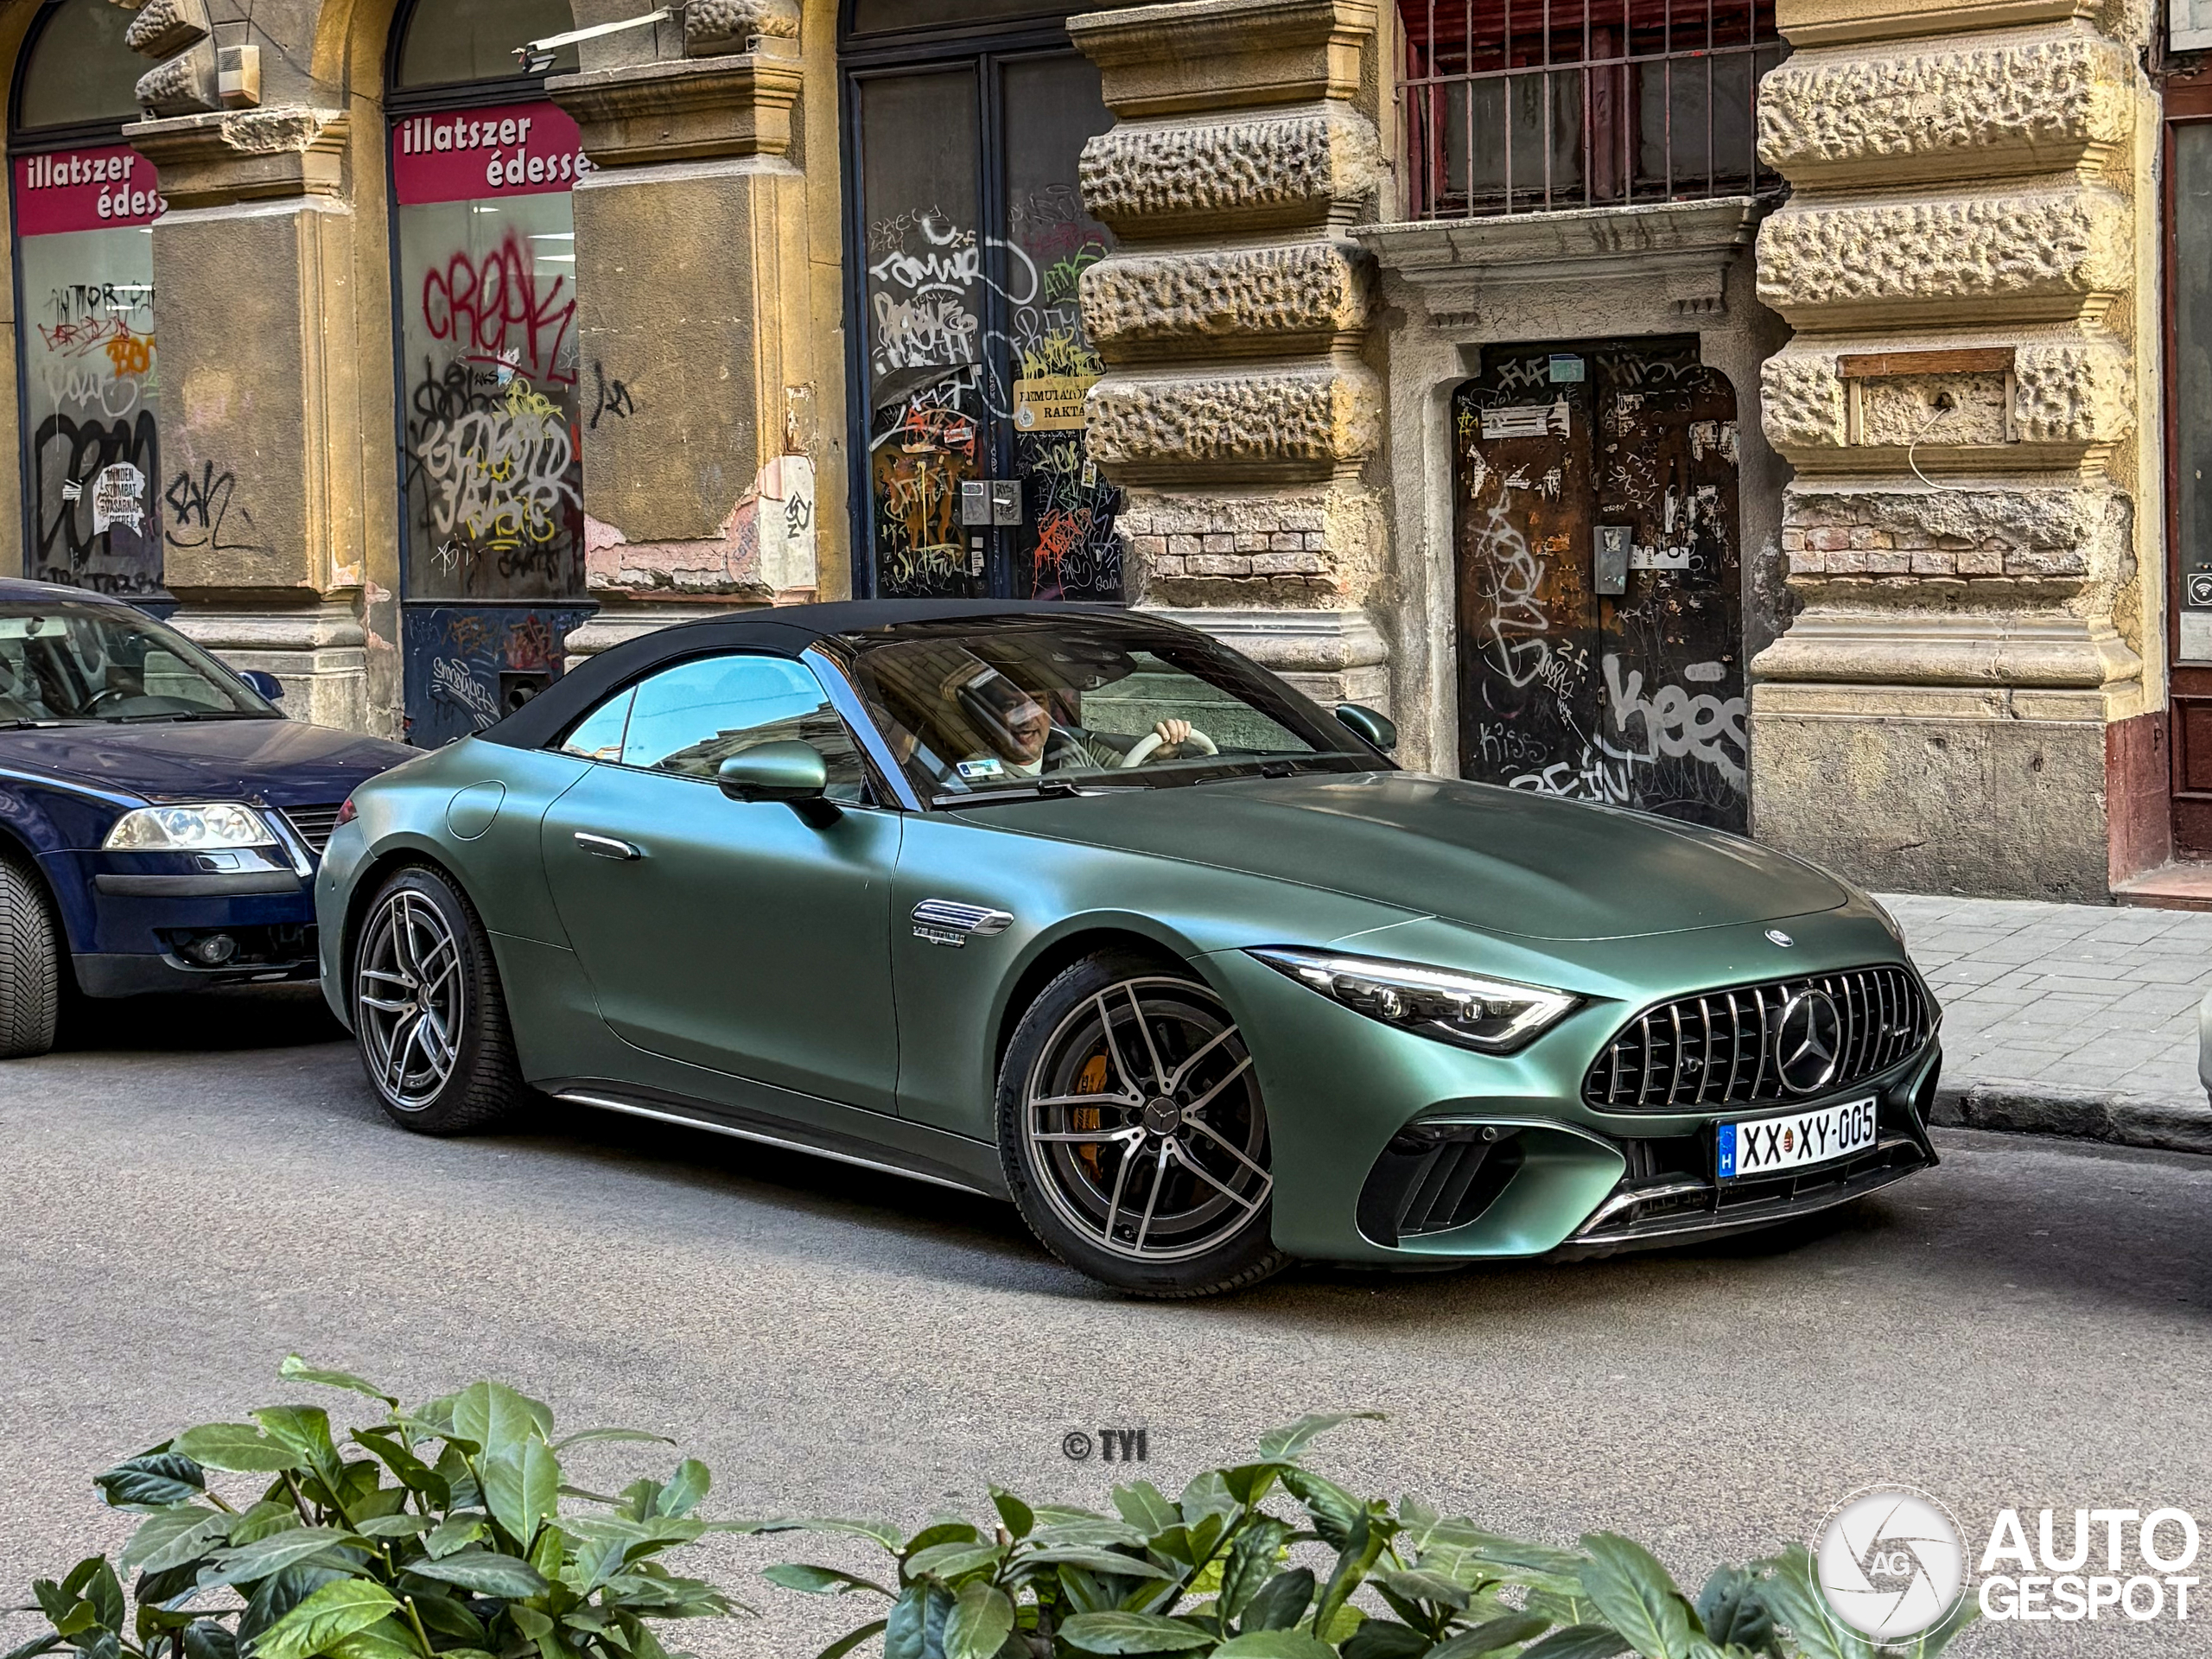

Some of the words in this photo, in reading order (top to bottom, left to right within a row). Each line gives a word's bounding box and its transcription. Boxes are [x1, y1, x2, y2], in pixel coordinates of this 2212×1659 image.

[403, 116, 531, 153] illatszer
[27, 155, 135, 189] illatszer
[1720, 1153, 1732, 1170] H
[1741, 1122, 1782, 1168] XX
